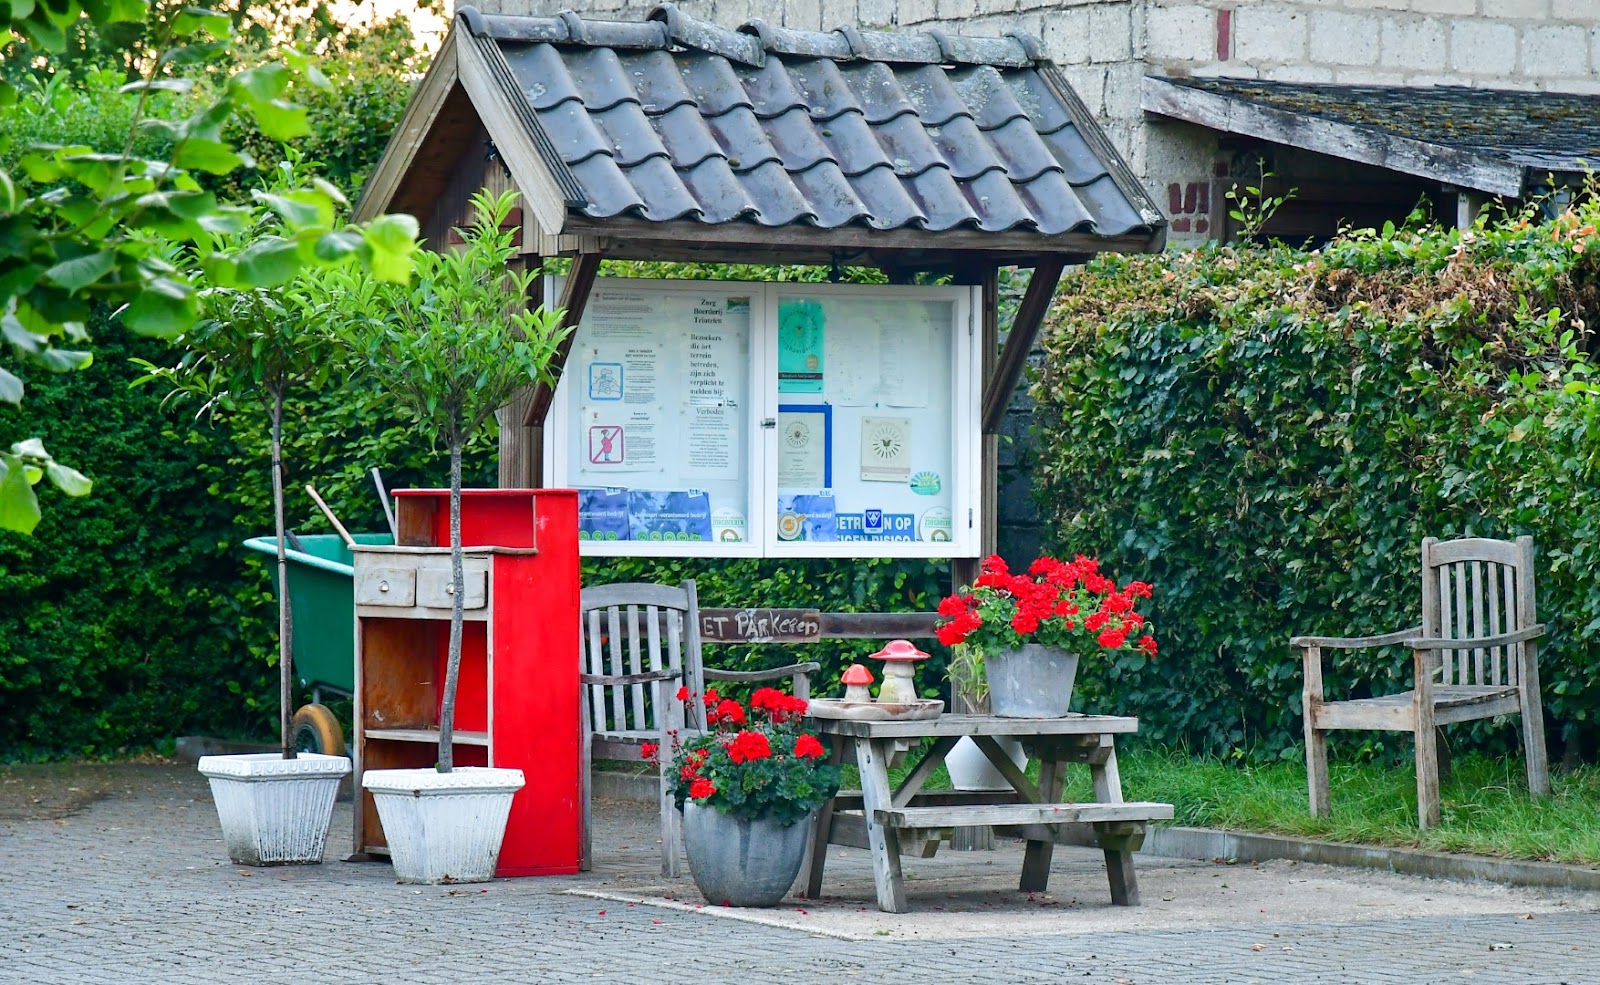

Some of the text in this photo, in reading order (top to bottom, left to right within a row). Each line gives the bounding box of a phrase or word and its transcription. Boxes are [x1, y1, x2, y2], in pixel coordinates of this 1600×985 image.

[701, 299, 716, 307] Zorg
[694, 308, 723, 316] Boerderij
[690, 333, 722, 341] Bezoekers
[690, 370, 702, 378] zijn
[895, 516, 912, 530] OP
